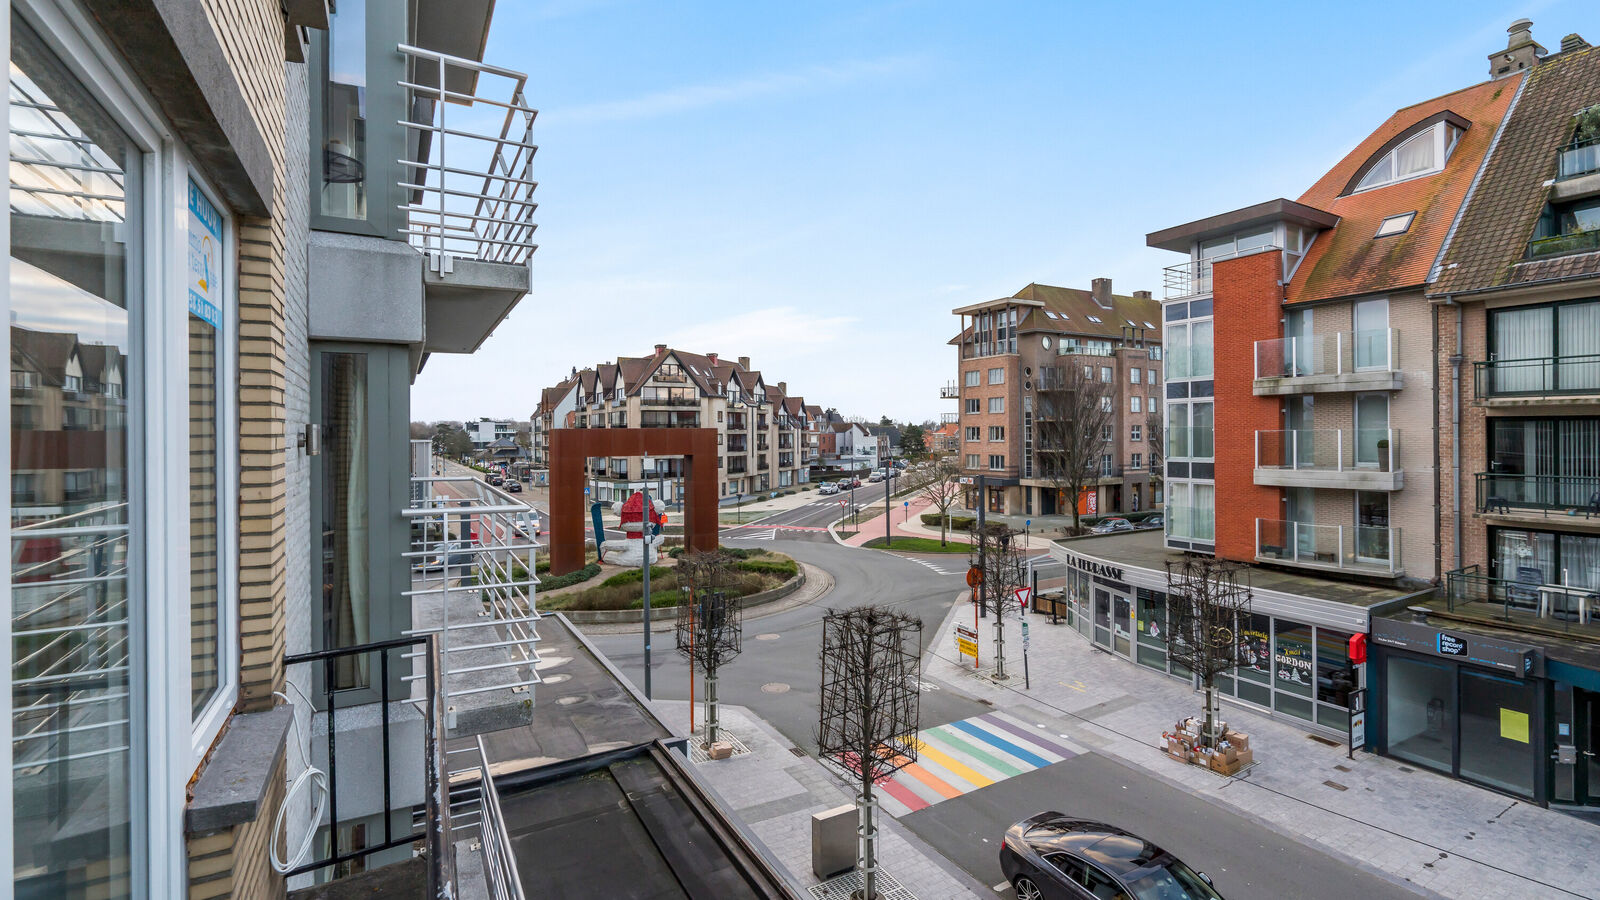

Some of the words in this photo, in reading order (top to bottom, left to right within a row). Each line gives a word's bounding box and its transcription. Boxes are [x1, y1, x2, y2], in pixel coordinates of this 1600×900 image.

[196, 192, 217, 232] HUUR
[1066, 554, 1077, 567] LA
[1078, 558, 1126, 582] TERRASSE
[1441, 634, 1456, 643] free
[1441, 640, 1463, 649] record
[1441, 646, 1459, 655] shop
[1275, 654, 1312, 670] GORDON
